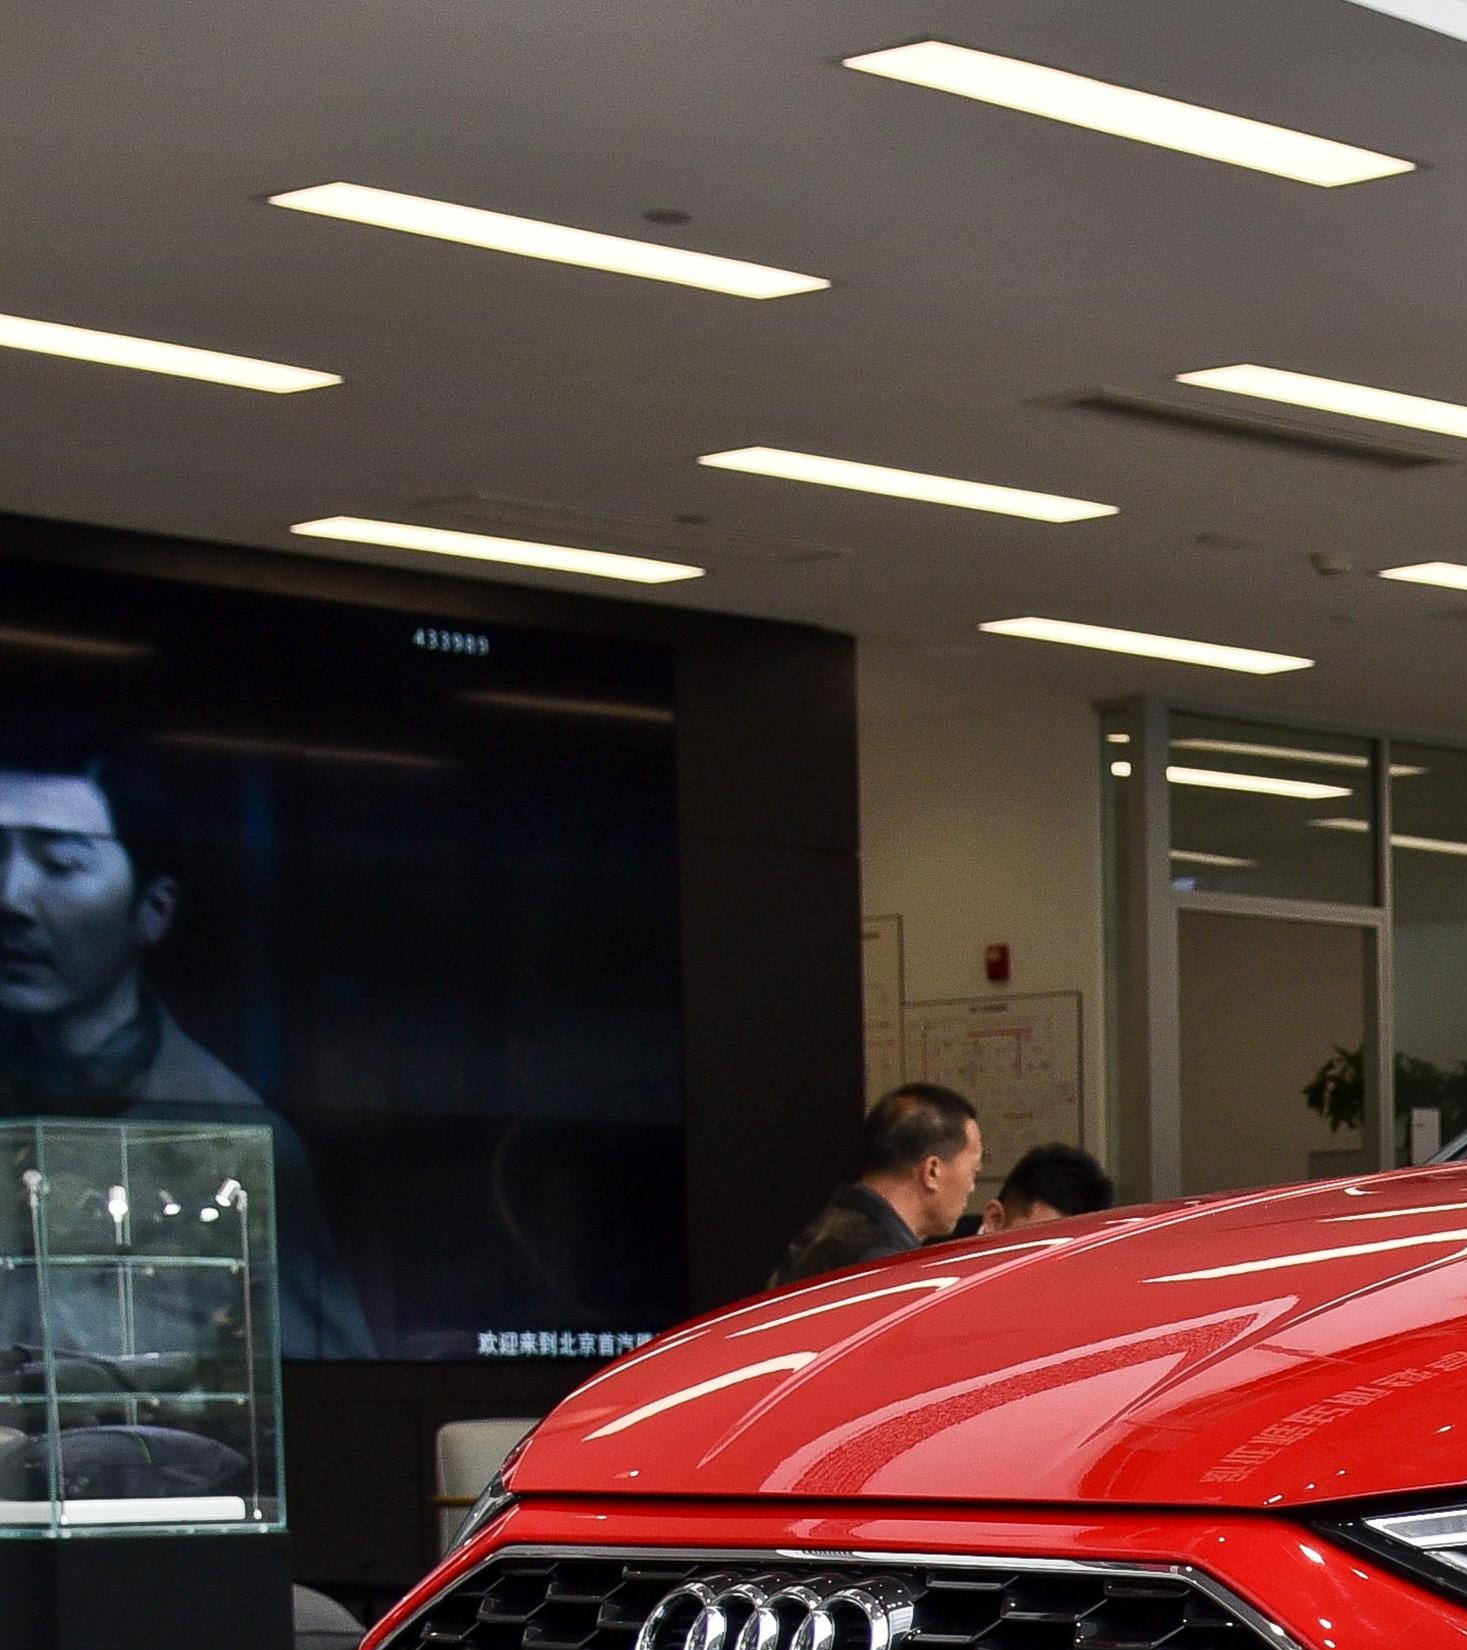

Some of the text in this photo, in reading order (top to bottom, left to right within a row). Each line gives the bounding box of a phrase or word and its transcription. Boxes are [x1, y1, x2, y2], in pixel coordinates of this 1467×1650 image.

[478, 1330, 660, 1357] 欢迎来到北京首汽
